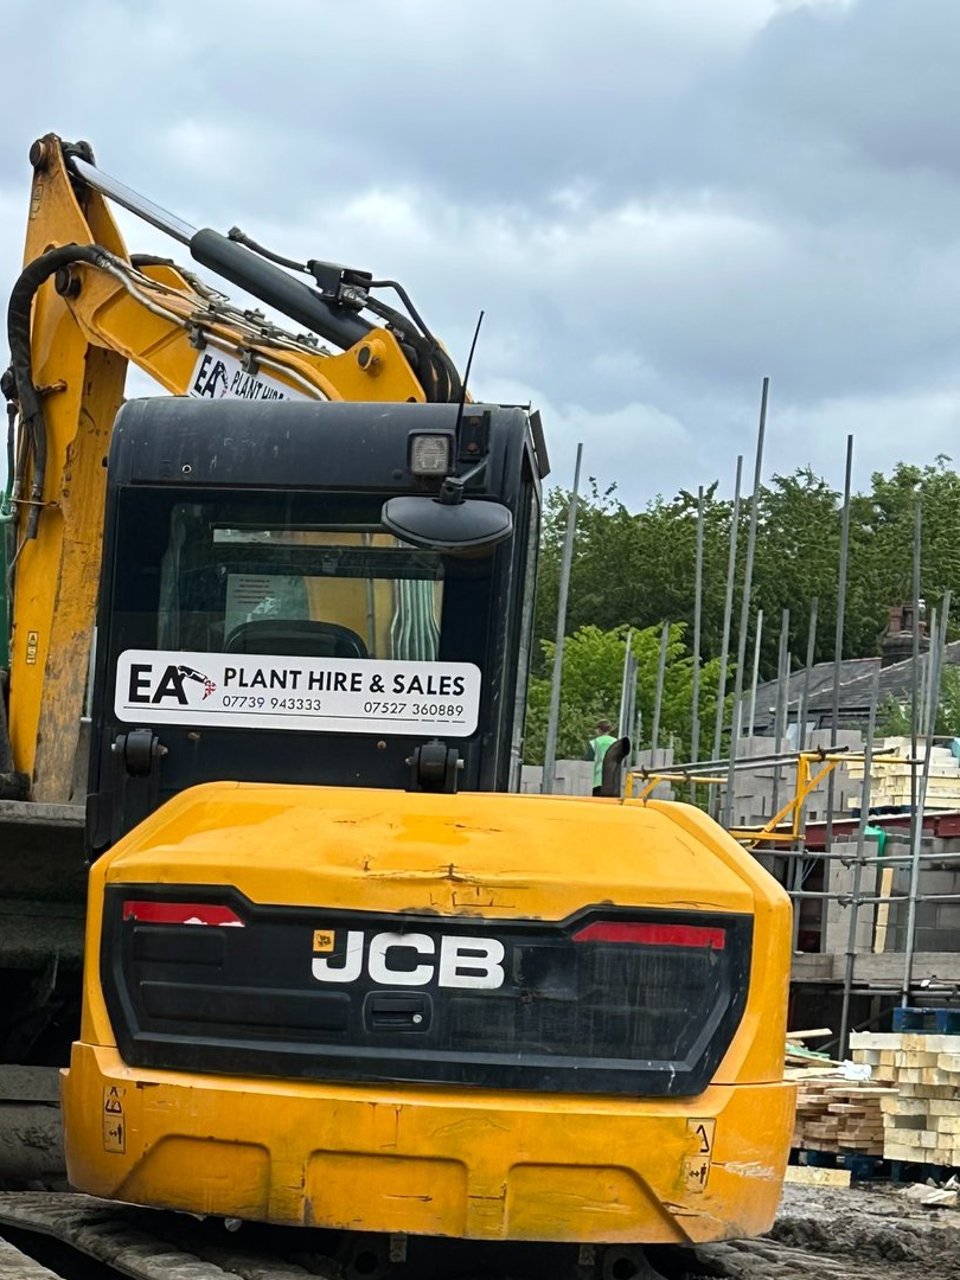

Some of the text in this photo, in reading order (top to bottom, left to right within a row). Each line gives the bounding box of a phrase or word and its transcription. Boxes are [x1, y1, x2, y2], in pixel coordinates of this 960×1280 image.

[194, 354, 225, 398] EA
[230, 370, 263, 399] PLANT
[128, 663, 189, 705] EA
[223, 667, 465, 696] PLANT HIRE & SALES
[222, 695, 321, 710] 07739 943333
[364, 701, 464, 717] 07527 360889
[311, 930, 505, 990] JCB
